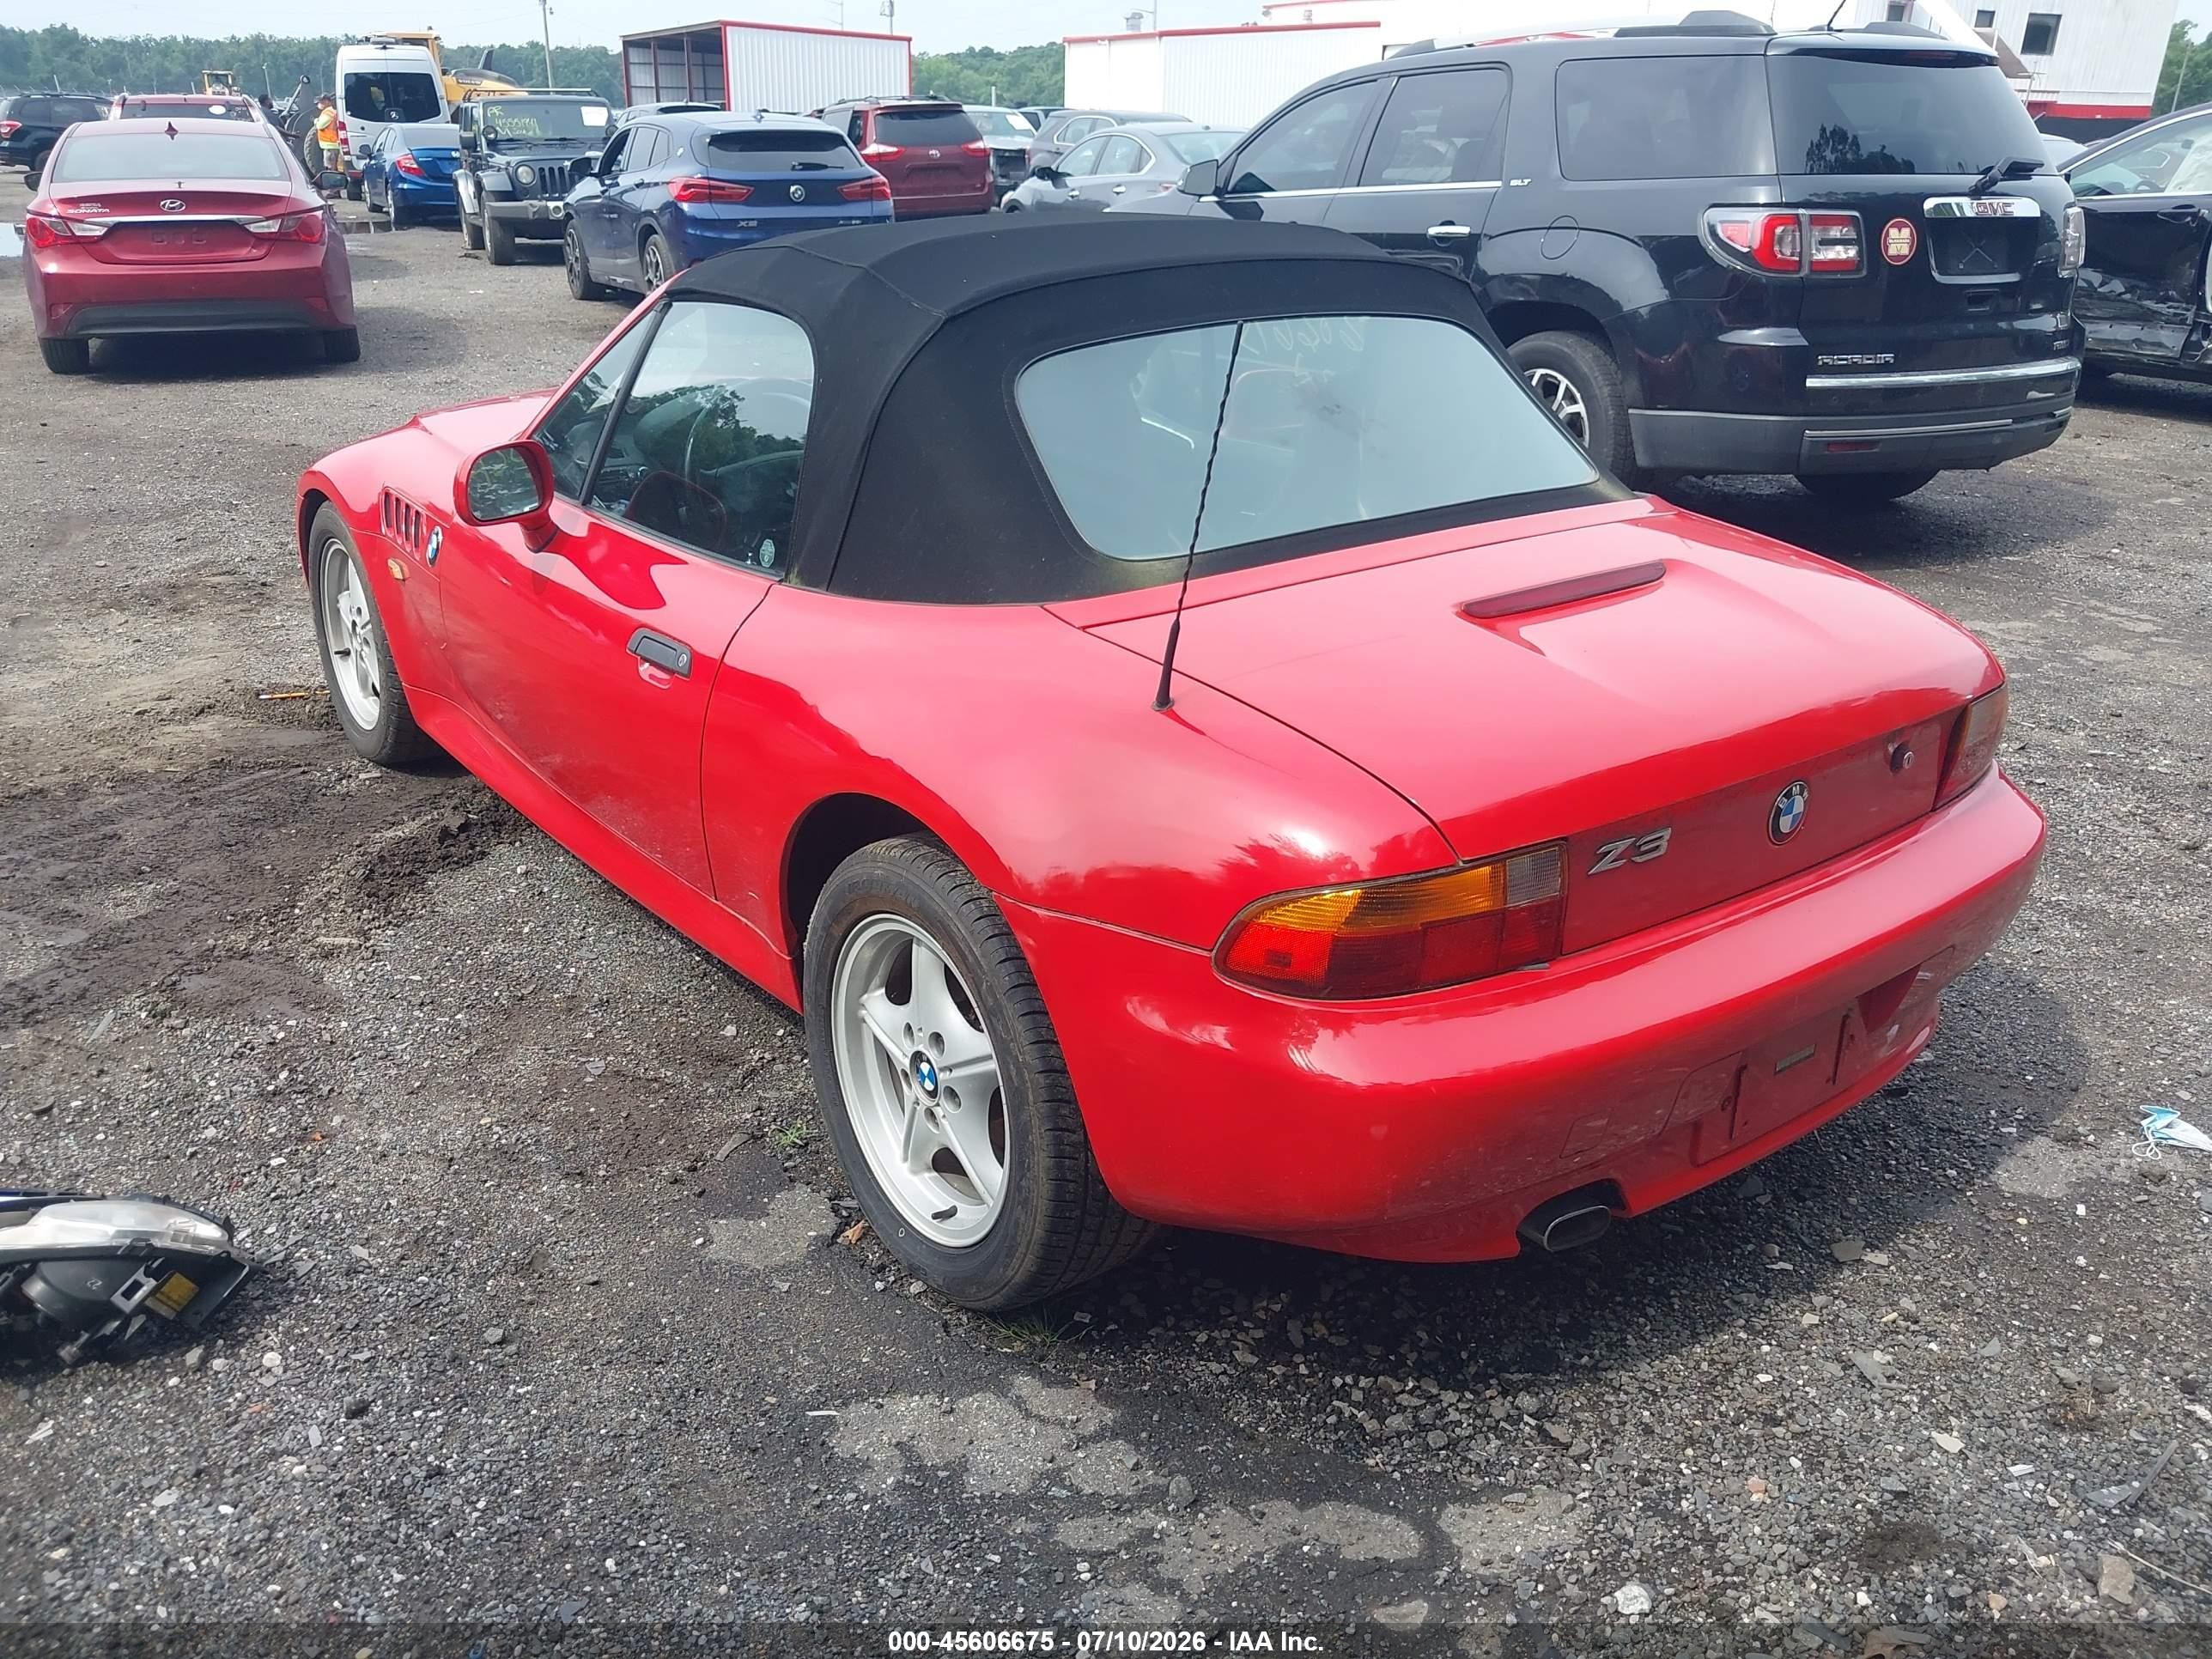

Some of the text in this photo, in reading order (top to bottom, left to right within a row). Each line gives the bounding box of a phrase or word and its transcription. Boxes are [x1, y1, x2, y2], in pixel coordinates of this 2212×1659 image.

[1976, 202, 2014, 216] GMC
[1817, 354, 1895, 366] ACADIA
[1587, 827, 1672, 876] Z3
